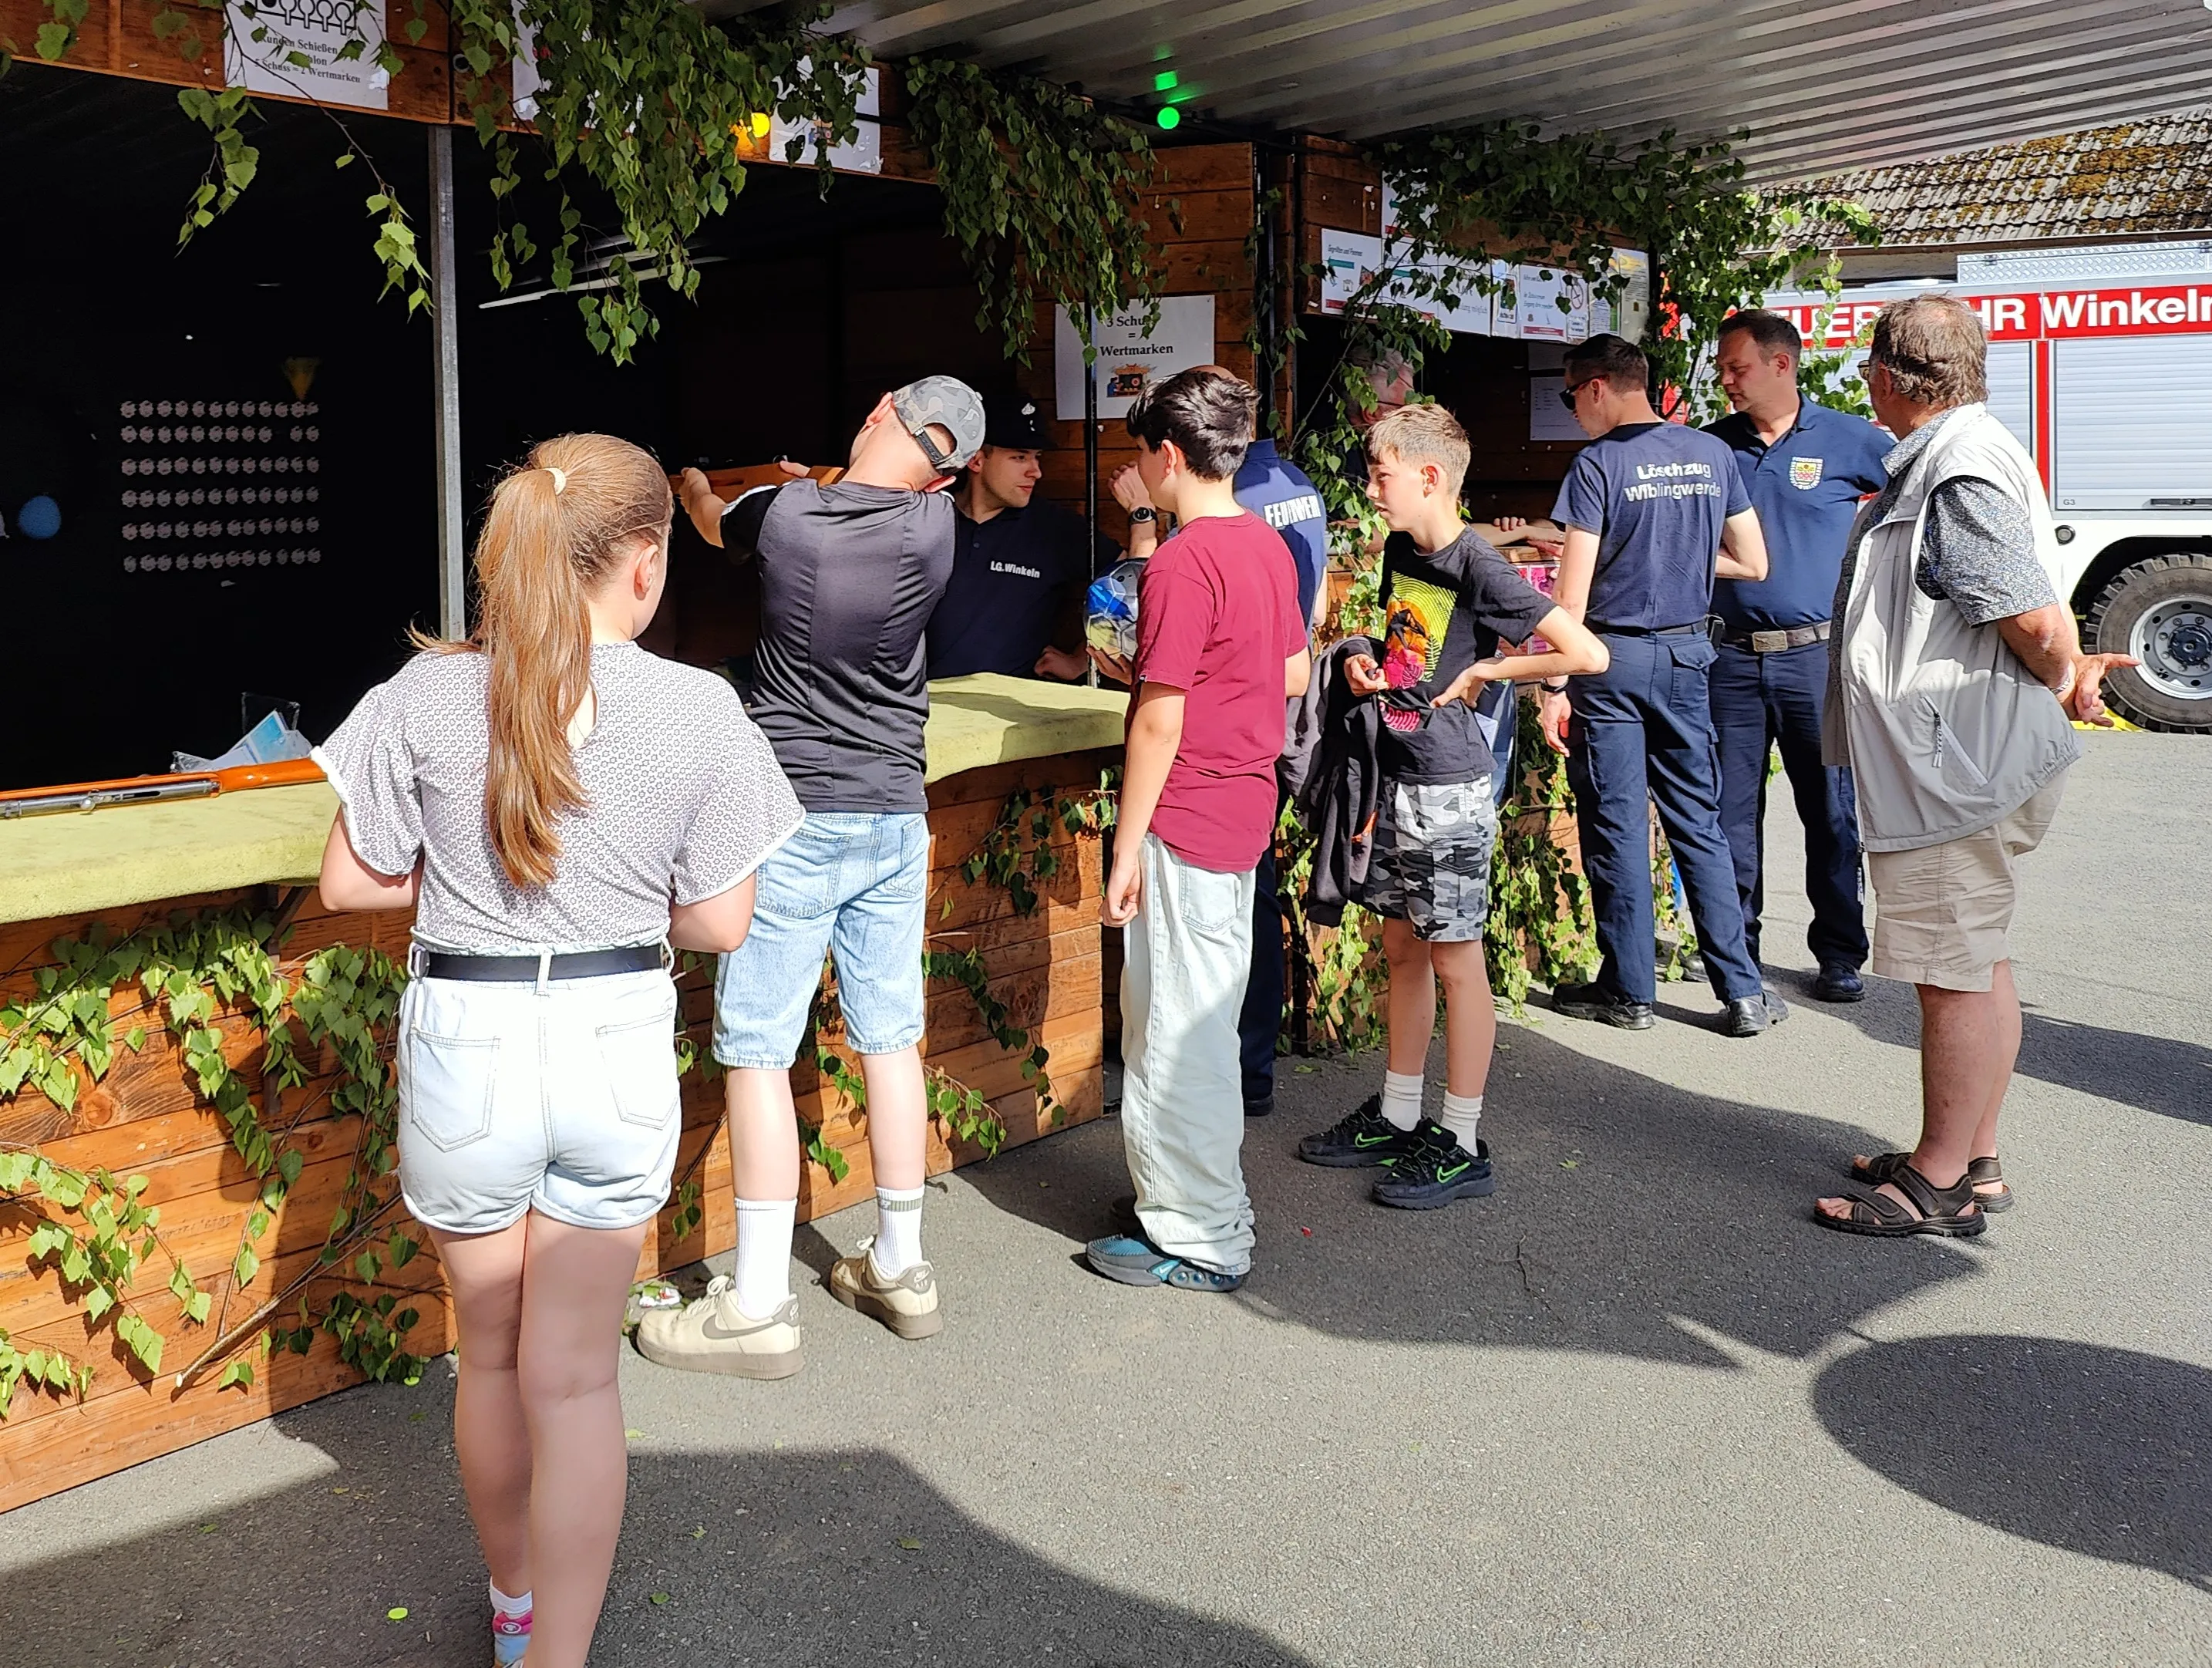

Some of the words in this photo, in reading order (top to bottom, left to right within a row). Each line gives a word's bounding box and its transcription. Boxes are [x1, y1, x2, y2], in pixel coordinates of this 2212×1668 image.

[298, 39, 338, 54] Schießen
[308, 67, 361, 83] Wertmarken
[1106, 316, 1113, 328] 3
[1116, 315, 1146, 327] Schu
[1100, 344, 1174, 356] Wertmarken
[1636, 463, 1712, 480] Löschzug
[1624, 482, 1722, 502] Wiblingwerde
